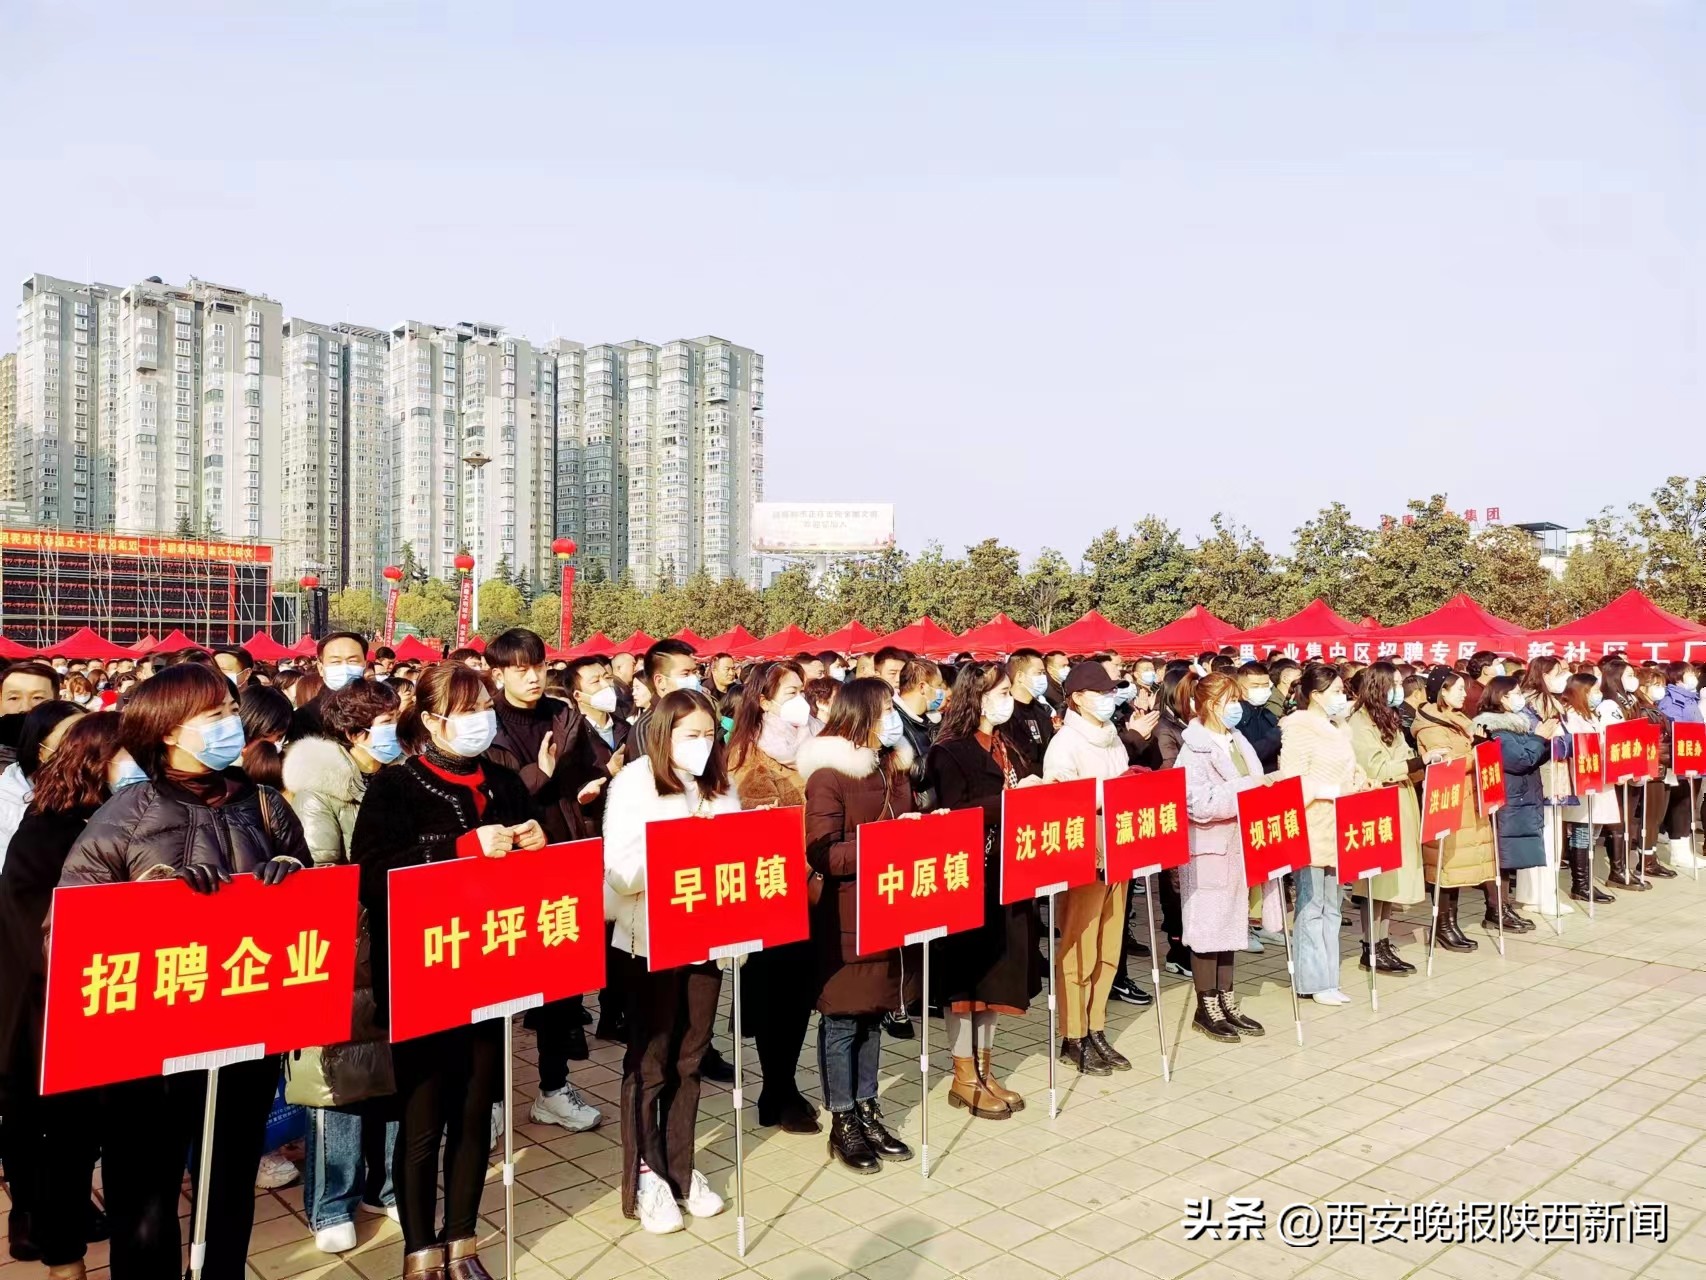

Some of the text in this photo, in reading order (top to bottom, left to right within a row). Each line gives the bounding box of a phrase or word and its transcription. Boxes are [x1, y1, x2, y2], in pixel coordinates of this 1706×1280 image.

[1429, 784, 1460, 815] 洪山镇
[1016, 815, 1085, 861] 沈坝镇
[1116, 802, 1178, 845] 瀛湖镇
[1249, 808, 1301, 848] 坝河镇
[1344, 816, 1393, 852] 大河镇
[670, 854, 788, 912] 早阳镇
[879, 851, 970, 905] 中原镇
[425, 895, 580, 970] 叶坪镇
[82, 929, 330, 1018] 招聘企业
